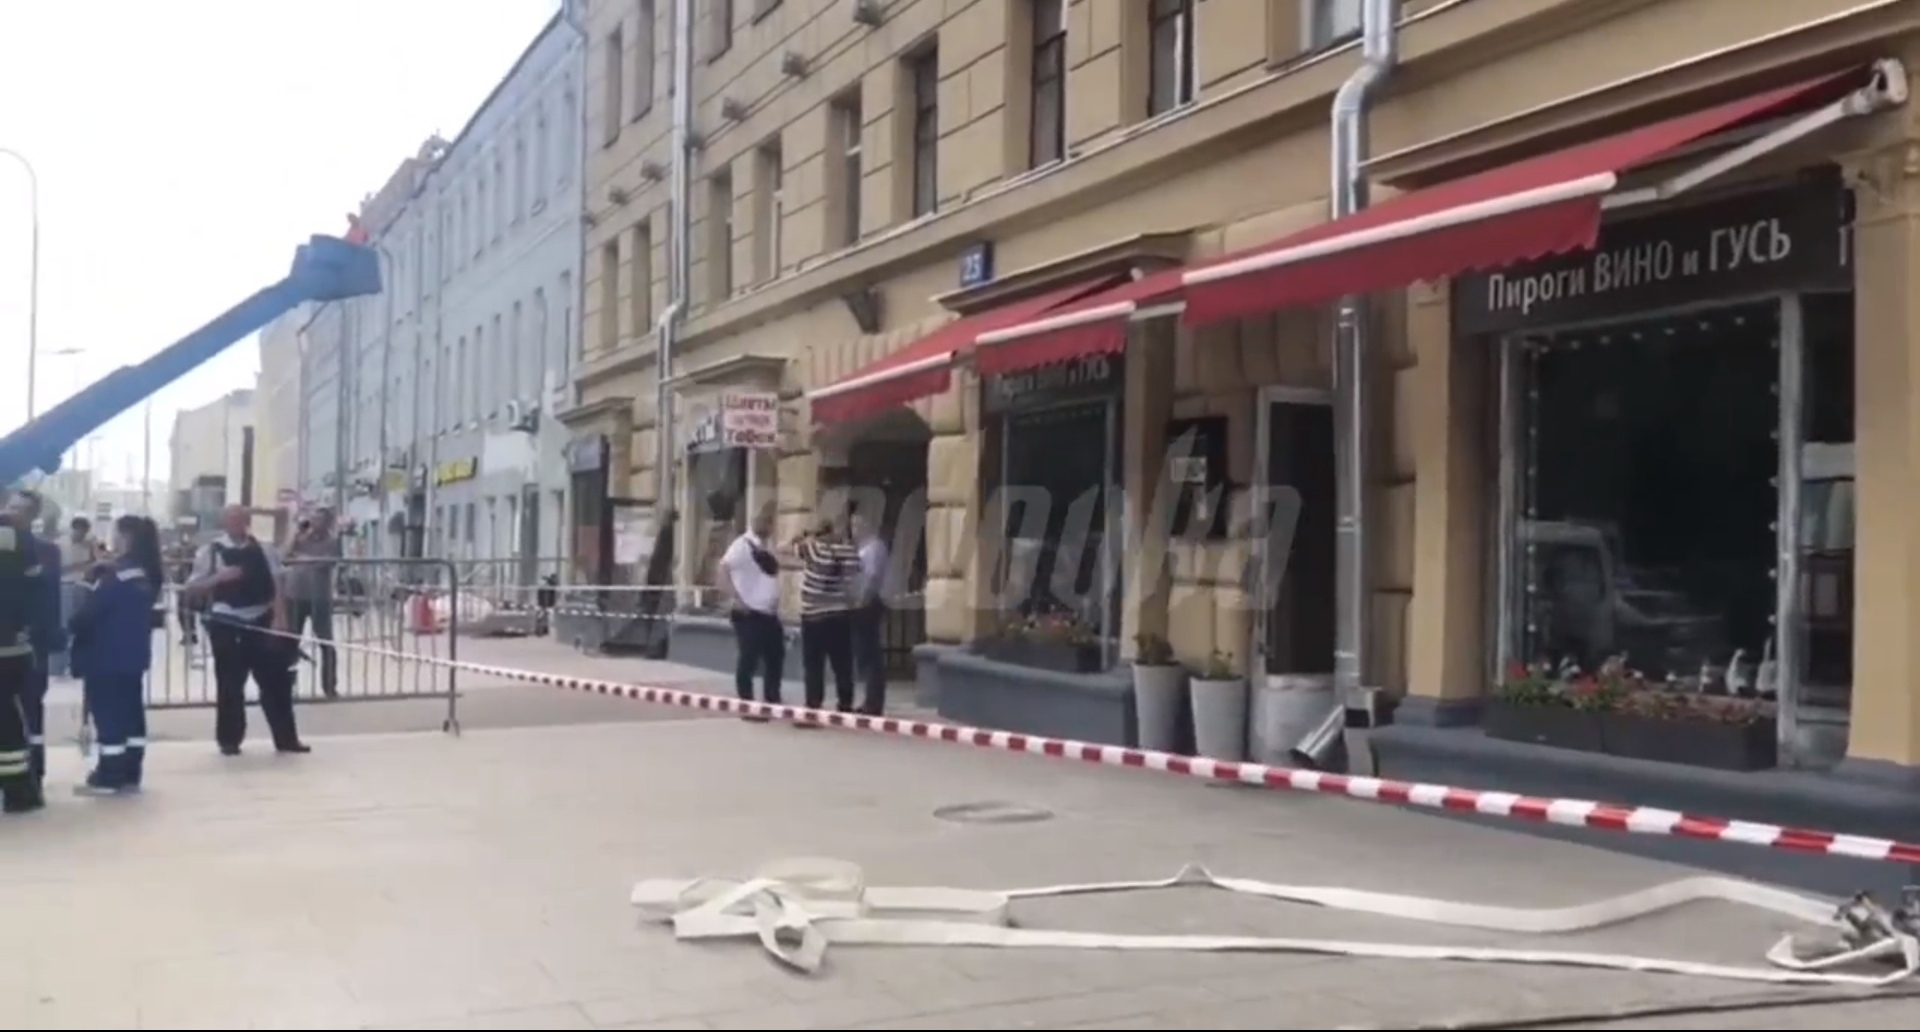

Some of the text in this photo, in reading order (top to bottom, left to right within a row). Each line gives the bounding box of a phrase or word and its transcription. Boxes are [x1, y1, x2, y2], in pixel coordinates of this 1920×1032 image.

[1488, 267, 1585, 314] Пироги
[1593, 240, 1674, 292] ВИНО
[1682, 249, 1699, 276] и
[1709, 217, 1792, 271] ГУСЬ
